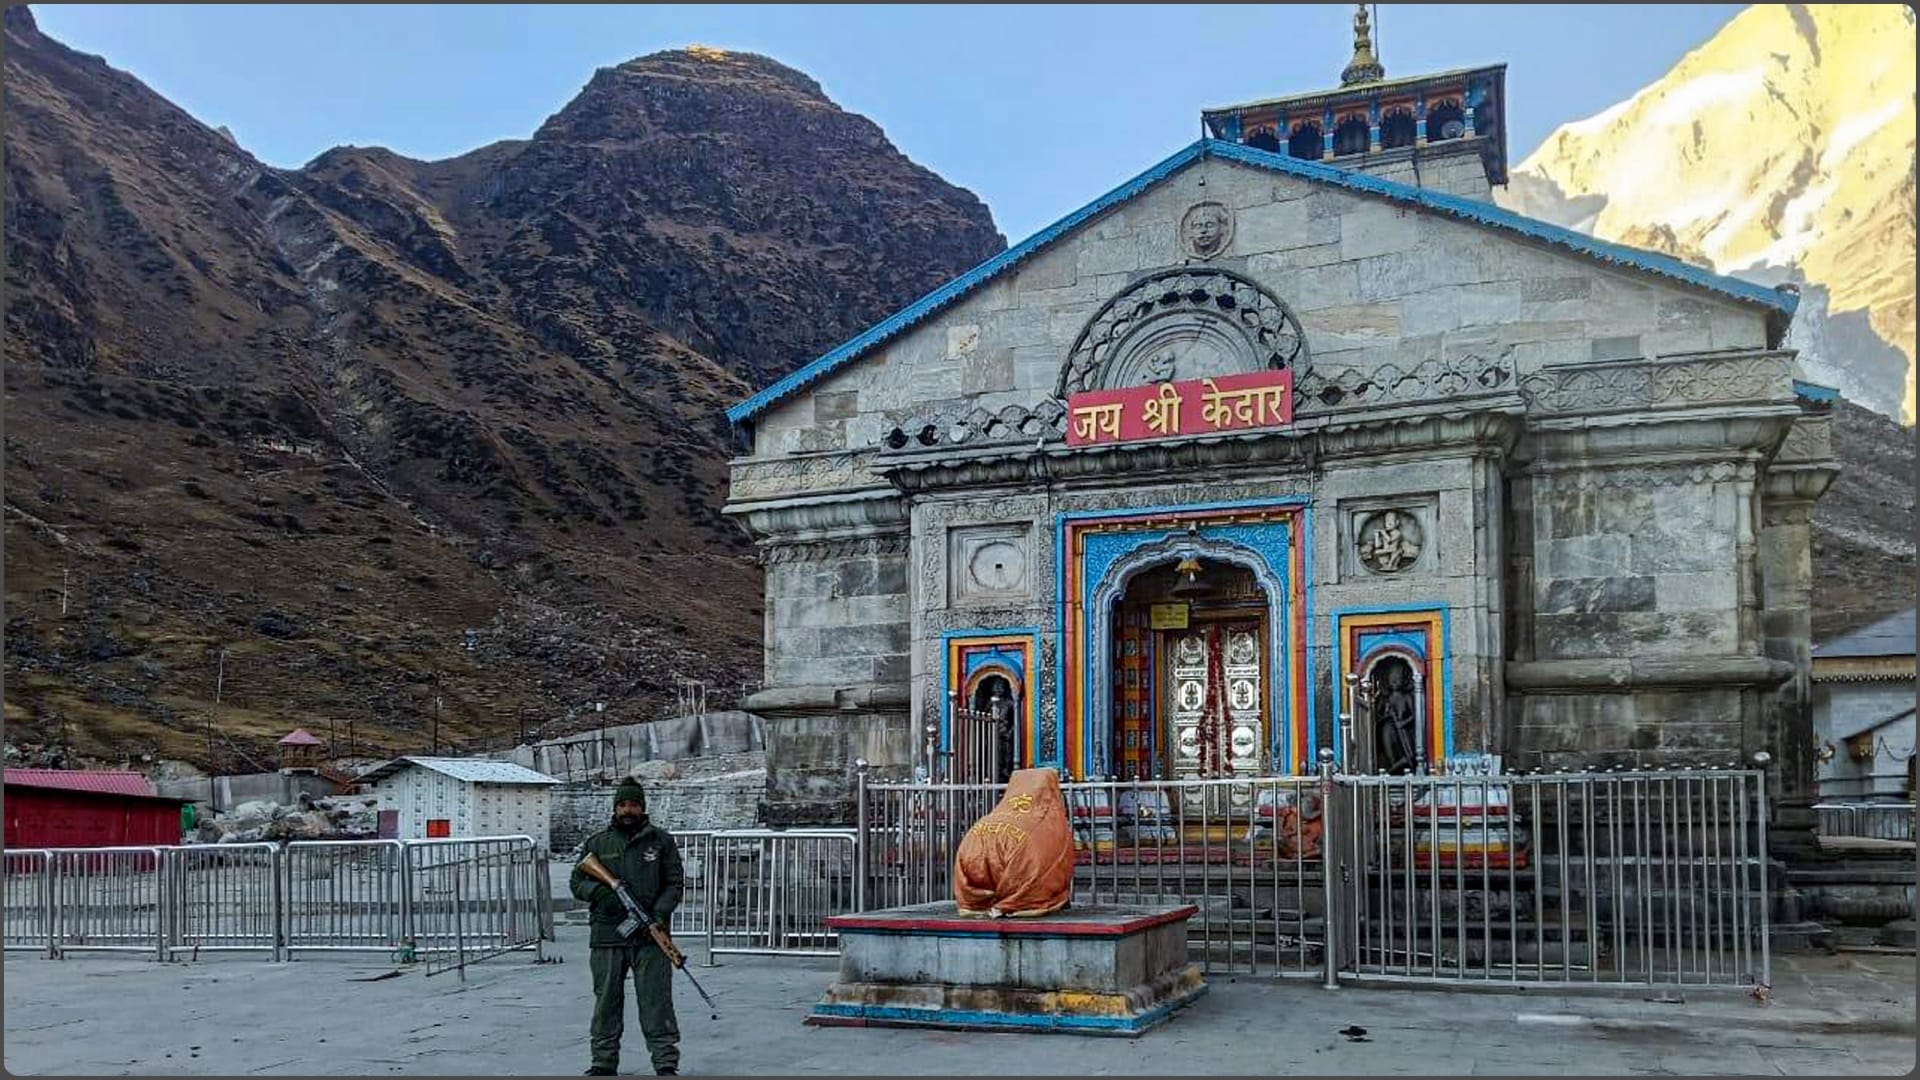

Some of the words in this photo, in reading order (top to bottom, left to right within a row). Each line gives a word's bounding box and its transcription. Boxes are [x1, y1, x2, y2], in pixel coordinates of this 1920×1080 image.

[1073, 403, 1123, 441] जय
[1141, 382, 1183, 434] श्री
[1201, 378, 1285, 427] केदार
